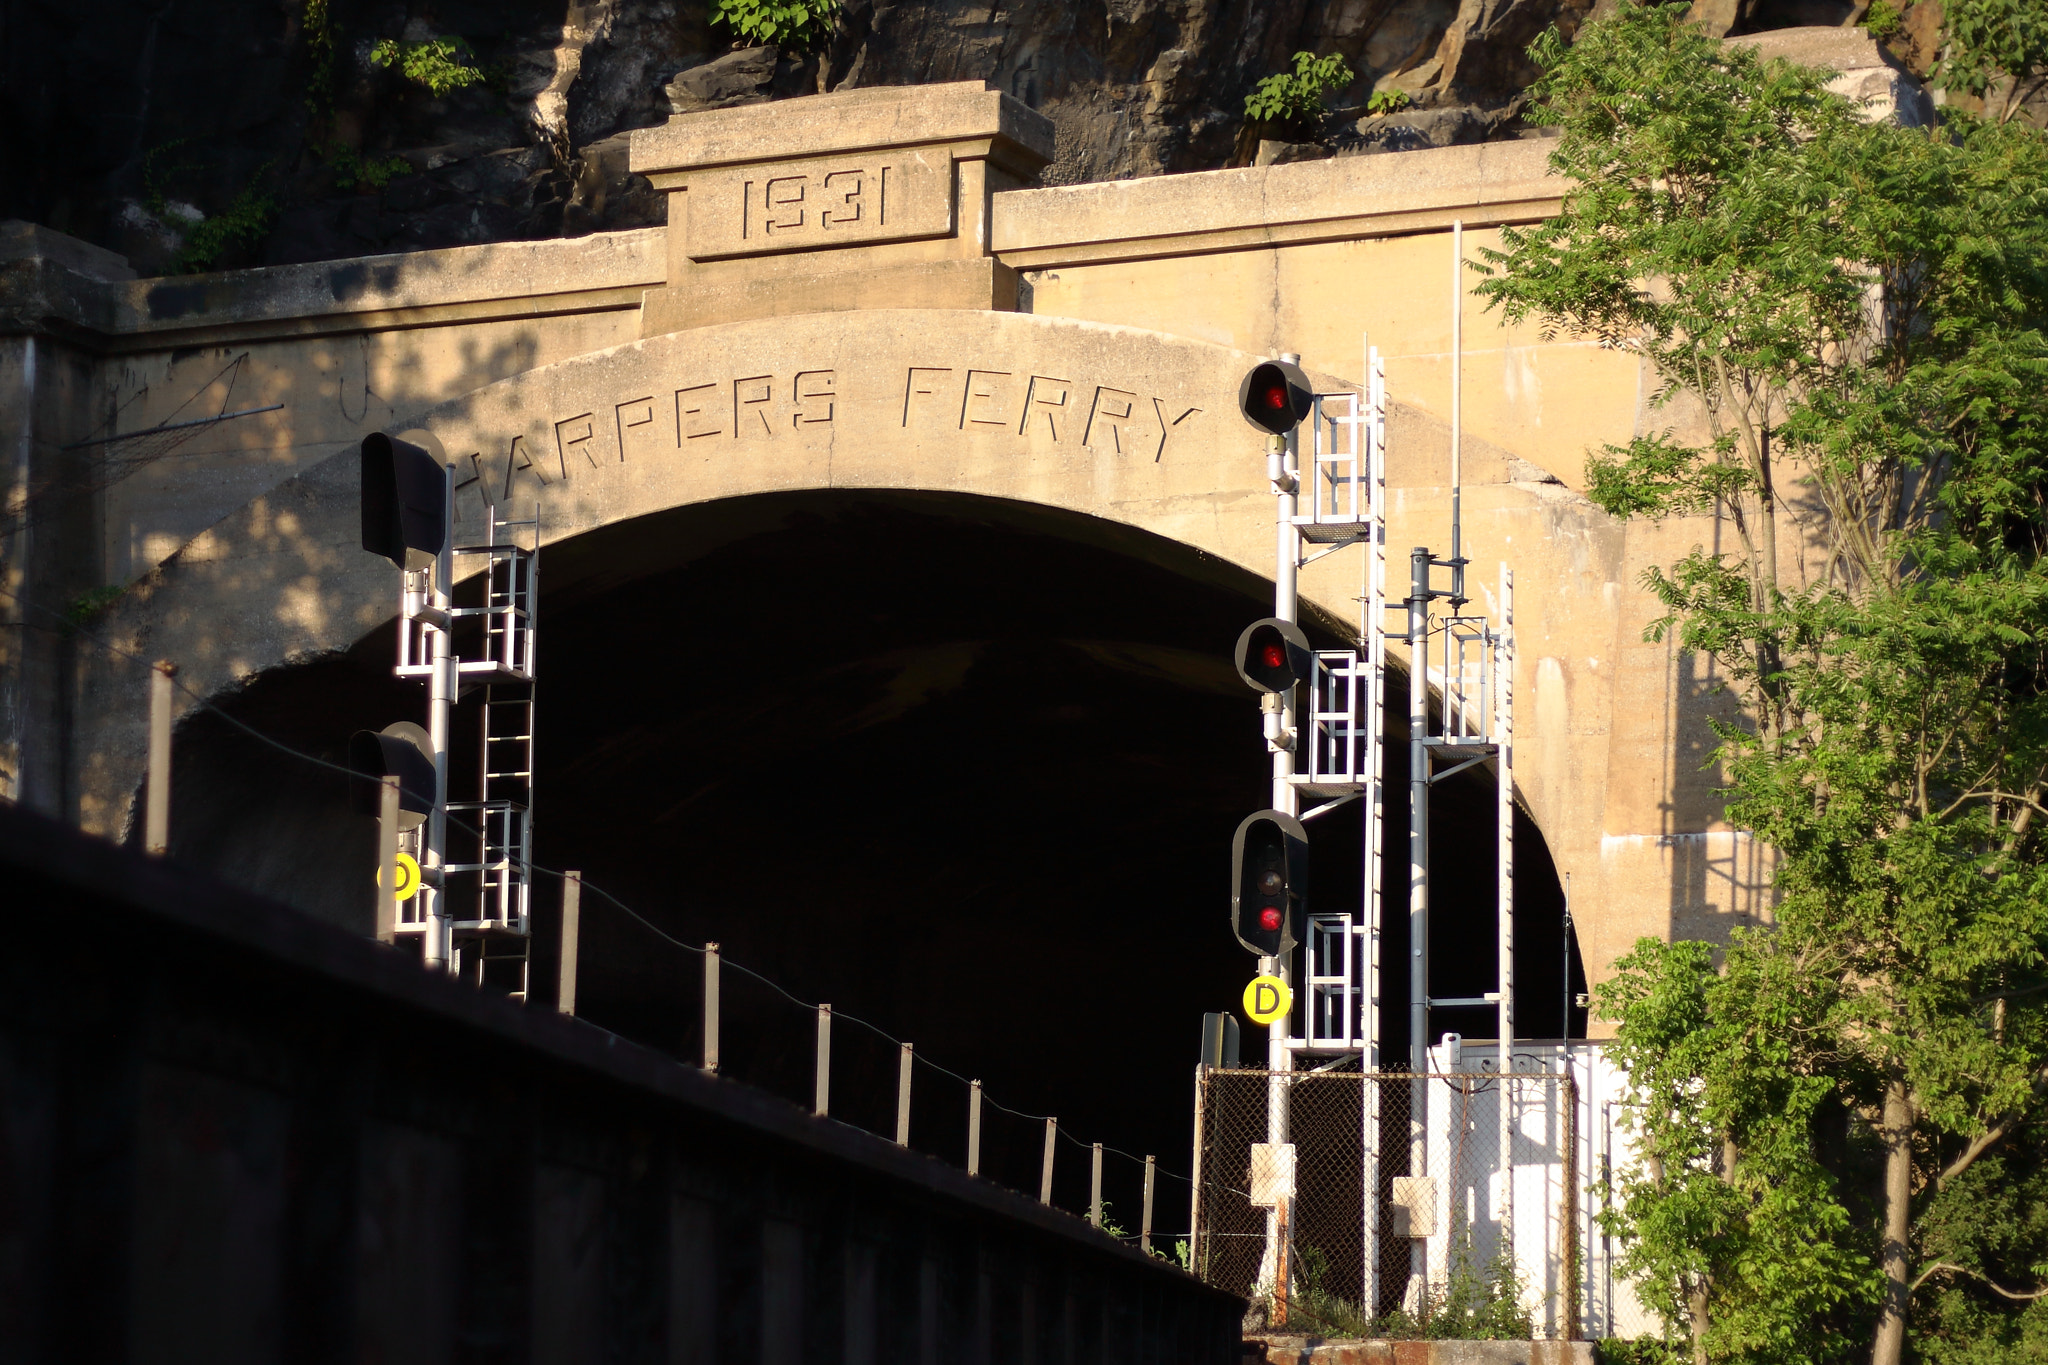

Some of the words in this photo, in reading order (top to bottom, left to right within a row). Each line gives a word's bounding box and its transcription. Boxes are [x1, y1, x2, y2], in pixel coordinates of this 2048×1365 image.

[743, 166, 892, 240] 1931
[902, 367, 1203, 463] FERRY
[1255, 983, 1280, 1014] D
